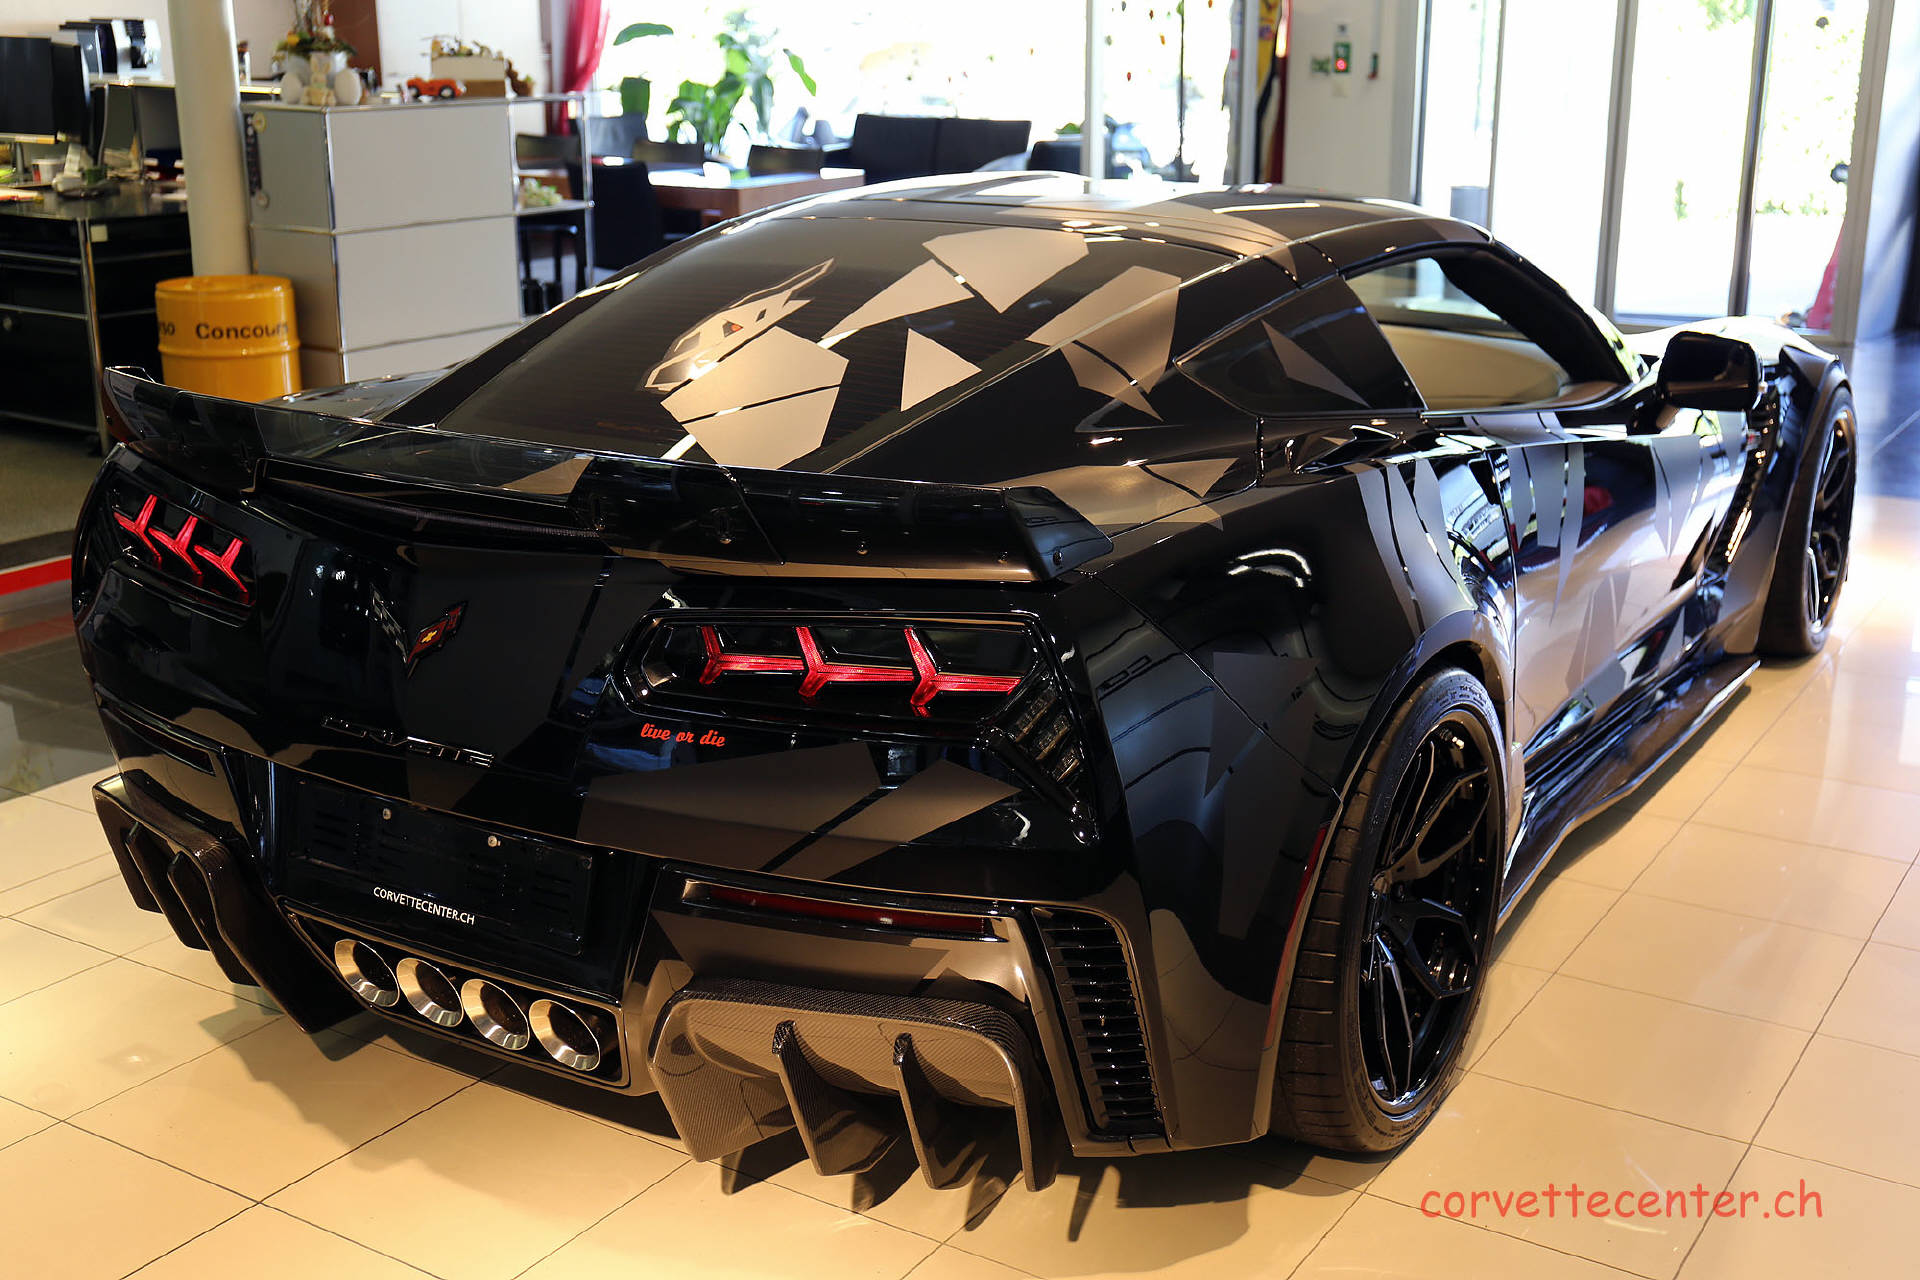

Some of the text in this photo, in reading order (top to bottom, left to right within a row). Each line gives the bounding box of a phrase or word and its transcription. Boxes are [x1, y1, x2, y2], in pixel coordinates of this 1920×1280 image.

[640, 722, 726, 747] live or die
[373, 886, 475, 926] CORVETTECENTER.CH
